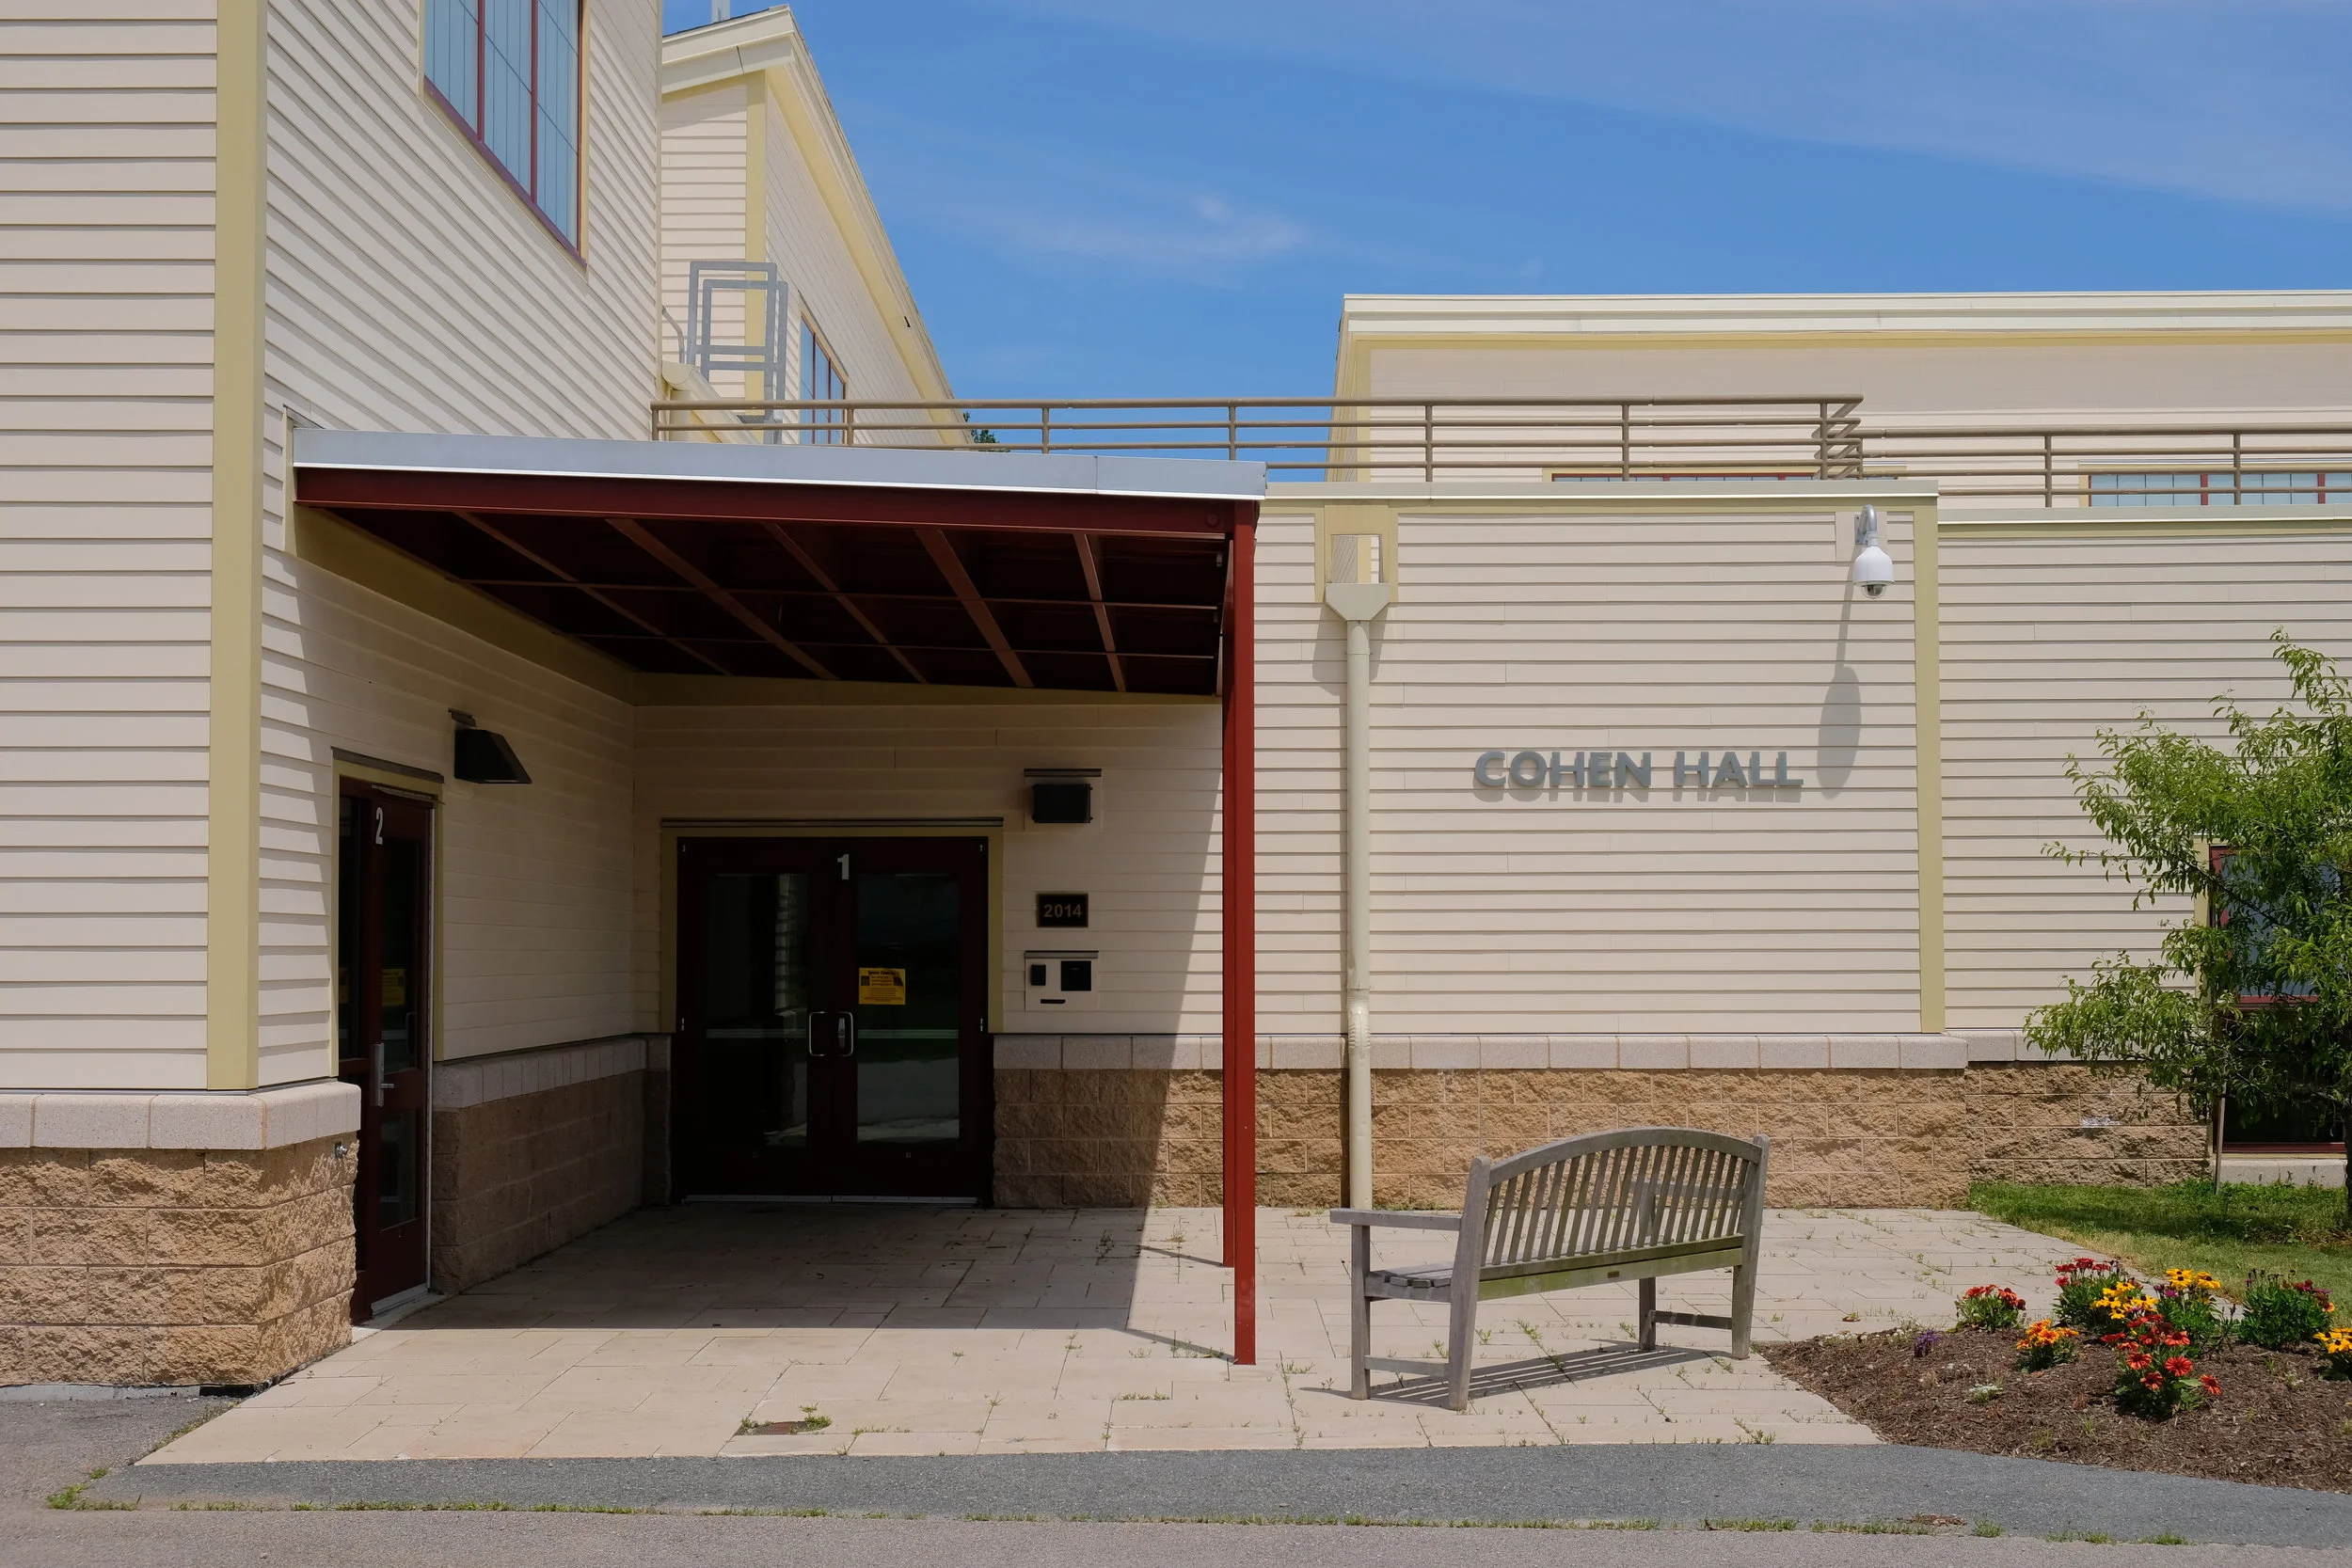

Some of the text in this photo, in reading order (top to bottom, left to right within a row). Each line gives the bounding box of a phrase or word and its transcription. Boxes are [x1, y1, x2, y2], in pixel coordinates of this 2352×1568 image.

[1474, 751, 1804, 788] COHEN HALL
[375, 806, 384, 845] 2
[836, 853, 850, 880] 1
[1043, 904, 1083, 918] 2014
